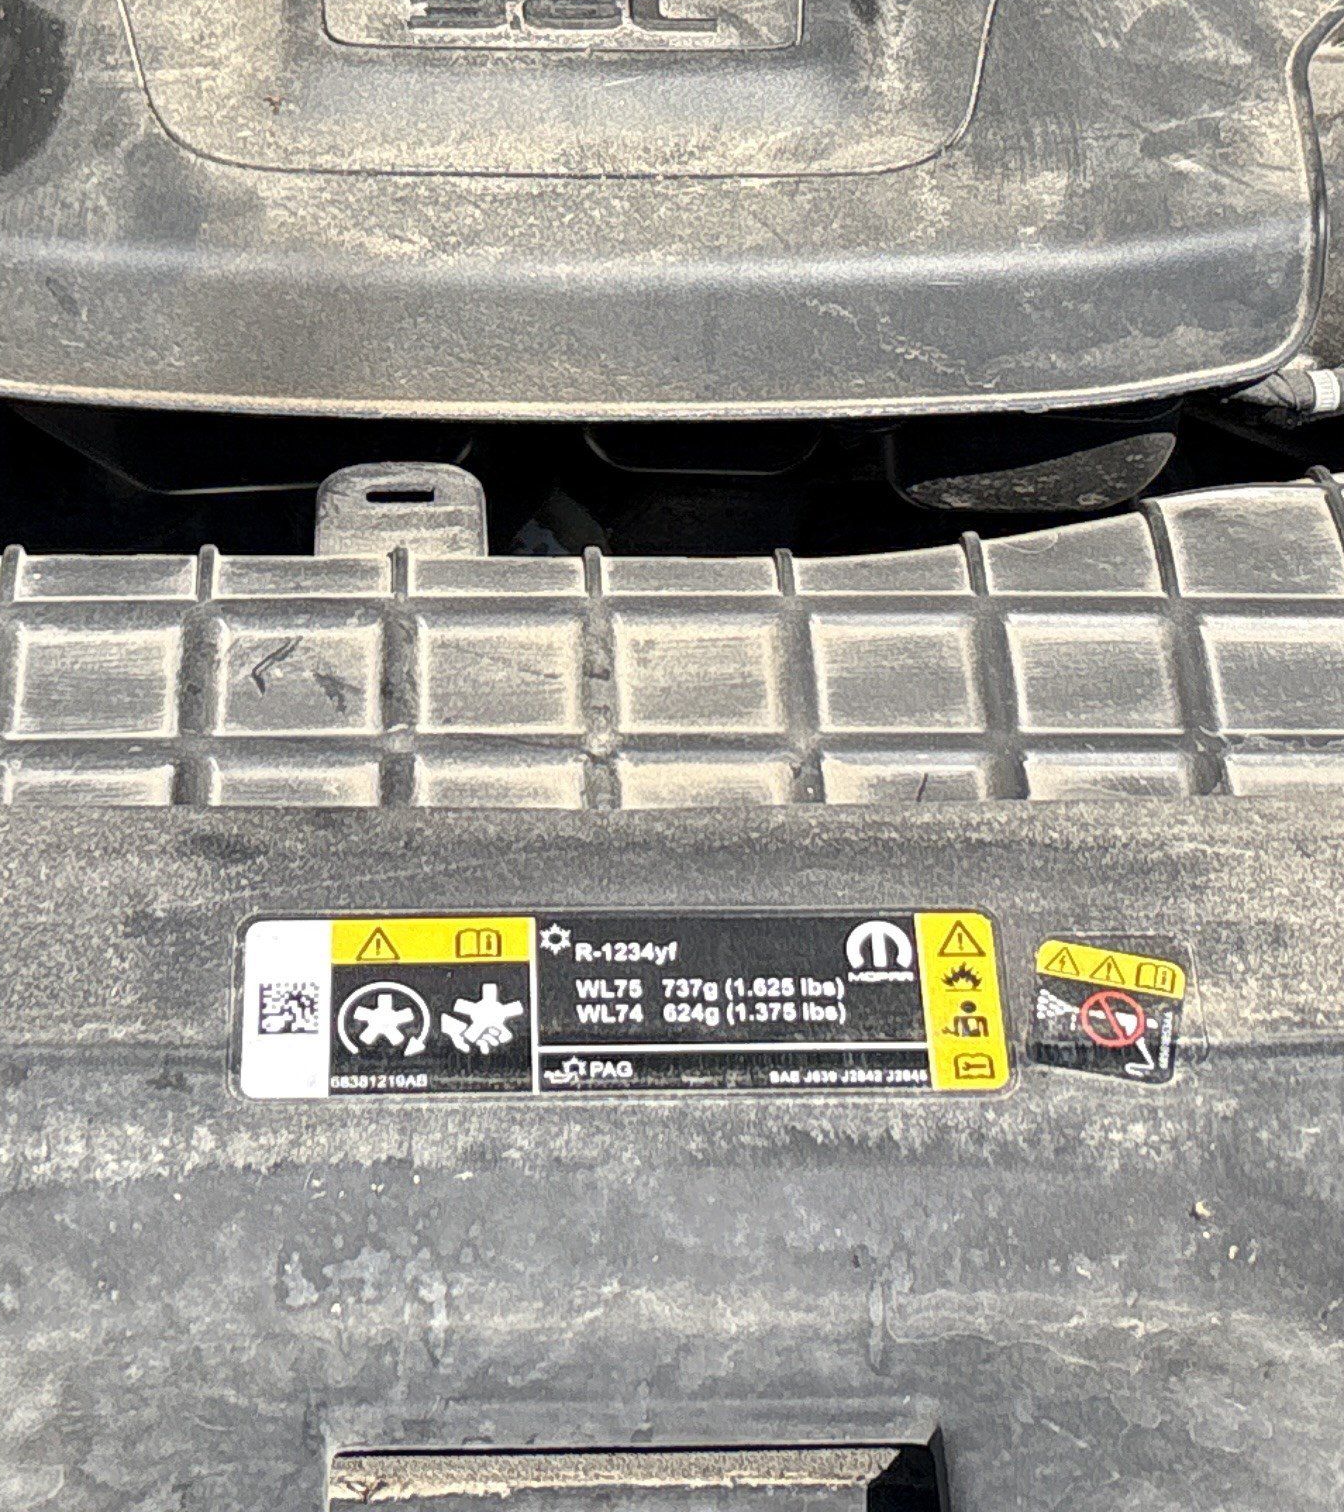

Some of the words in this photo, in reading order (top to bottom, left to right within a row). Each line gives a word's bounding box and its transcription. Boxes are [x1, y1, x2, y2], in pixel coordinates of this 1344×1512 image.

[574, 941, 678, 966] R-1234yf
[576, 978, 643, 999] WL75
[662, 978, 718, 1001] 737g
[725, 977, 793, 1001] (1.625
[800, 977, 845, 1001] lbs)
[576, 1003, 644, 1024] WL74
[663, 1003, 719, 1026] 624g
[726, 1002, 797, 1026] (1.375
[803, 1002, 846, 1025] lbs)
[590, 1060, 634, 1079] PAG
